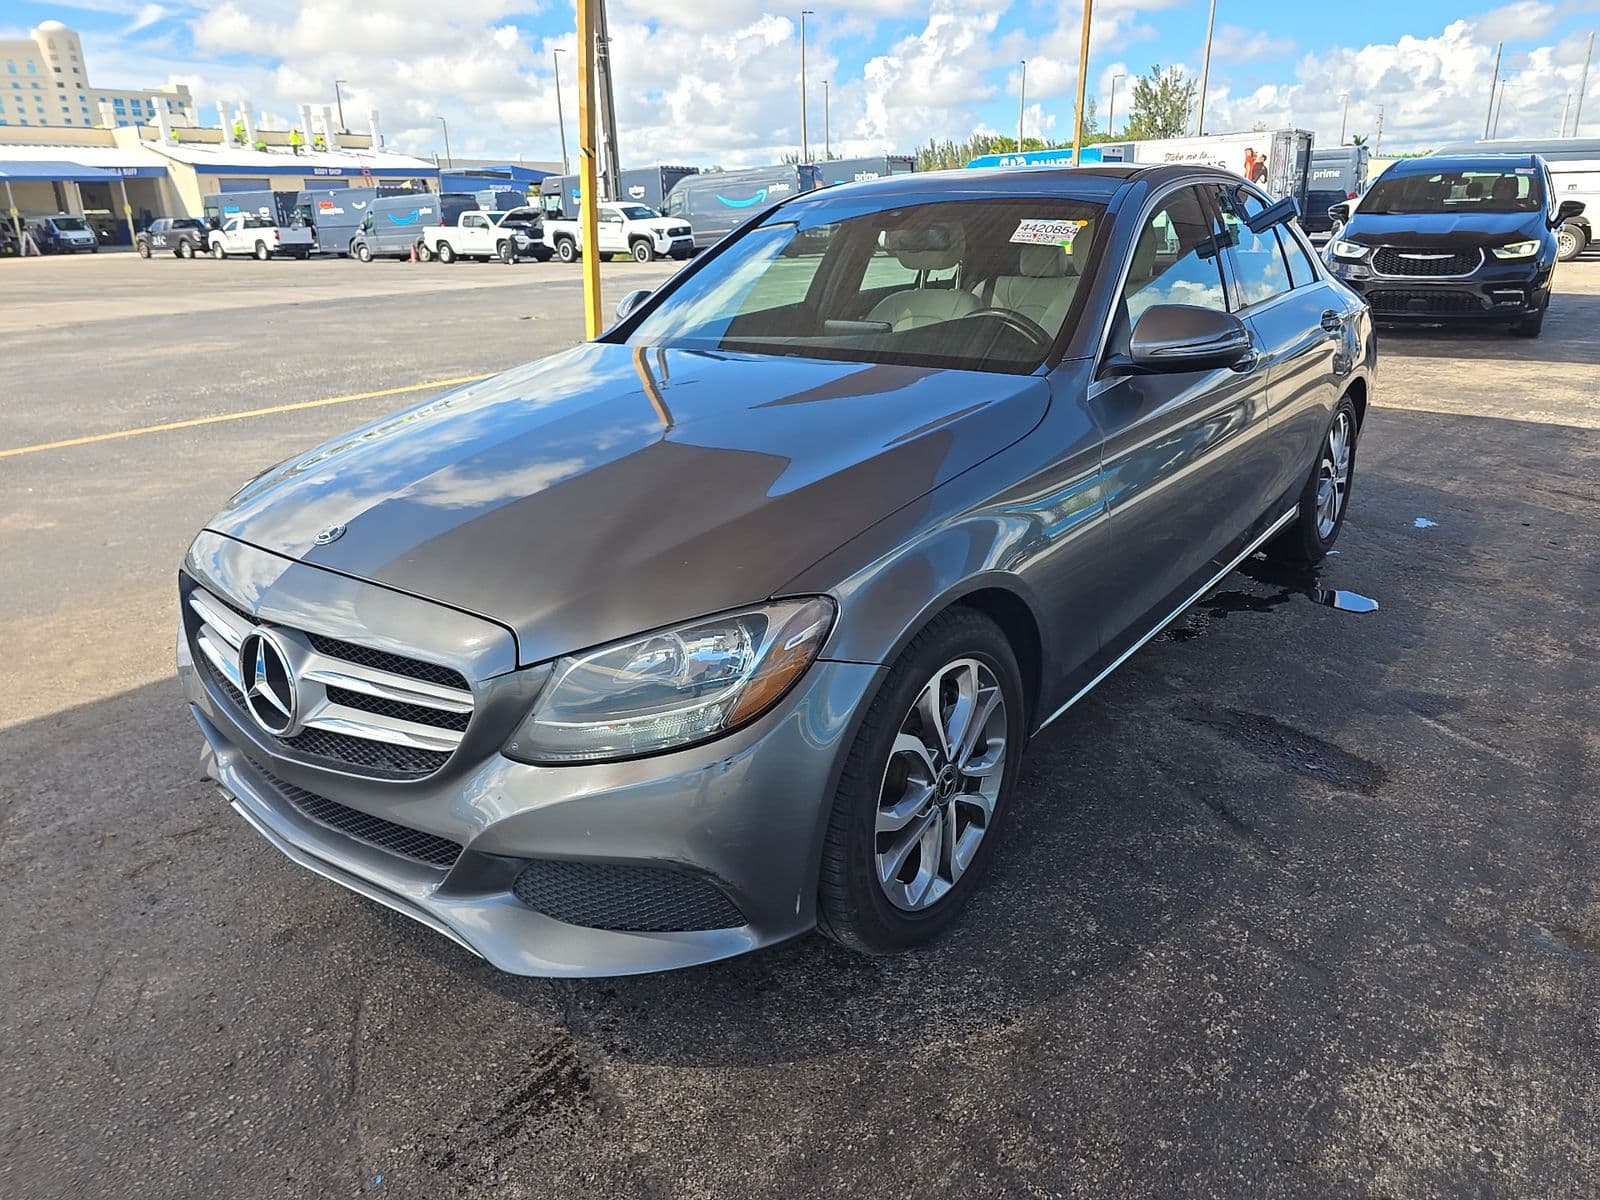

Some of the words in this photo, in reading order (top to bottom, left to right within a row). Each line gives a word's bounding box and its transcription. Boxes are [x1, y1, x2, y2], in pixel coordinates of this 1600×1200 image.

[854, 171, 879, 182] prime
[1313, 169, 1341, 181] prime
[768, 183, 790, 194] prime
[1020, 224, 1078, 235] 4420854
